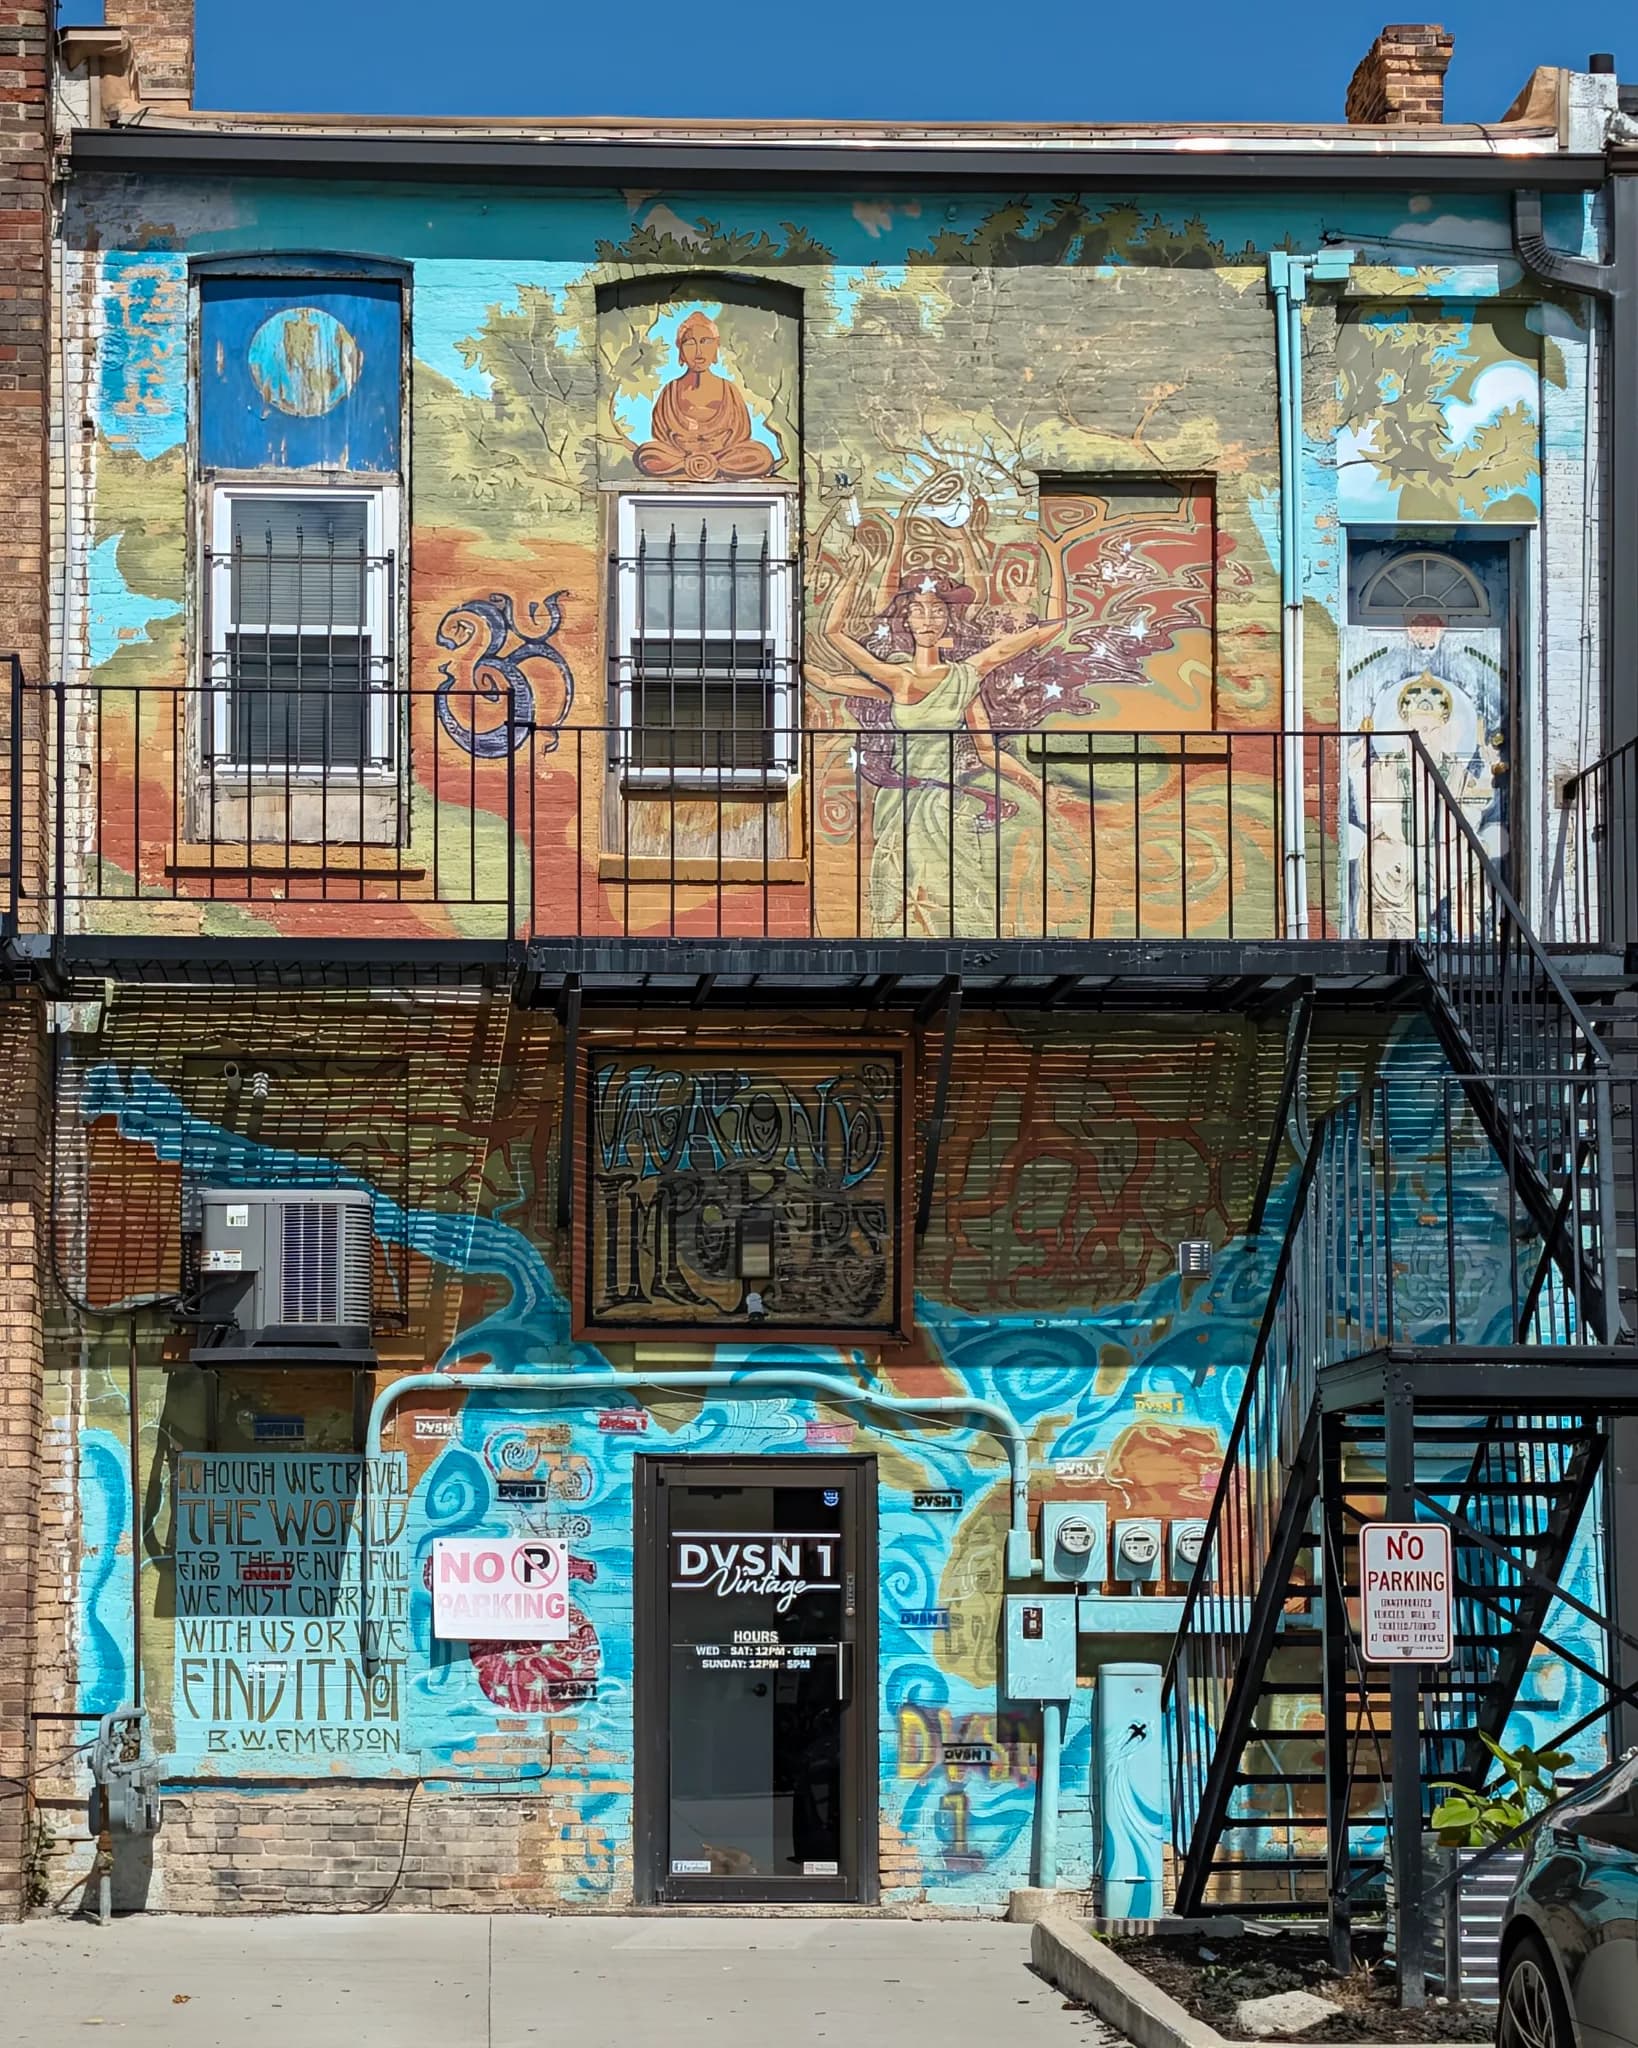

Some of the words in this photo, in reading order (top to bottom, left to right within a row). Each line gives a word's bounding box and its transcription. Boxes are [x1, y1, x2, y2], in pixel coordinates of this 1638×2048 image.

[284, 1462, 324, 1494] WE
[179, 1499, 262, 1545] THE
[269, 1499, 408, 1546] WORLD
[178, 1551, 220, 1563] TO
[680, 1544, 801, 1577] DVSN
[817, 1545, 831, 1577] 1
[1387, 1536, 1424, 1560] NO
[283, 1551, 408, 1580] BEAUTFUL
[440, 1552, 505, 1583] NO
[717, 1565, 807, 1613] Vintage
[1368, 1571, 1444, 1591] PARKING
[180, 1586, 221, 1615] WE
[228, 1585, 292, 1615] MUST
[299, 1586, 376, 1616] CARRY
[382, 1586, 408, 1616] IT
[438, 1592, 565, 1619] PARKING
[180, 1621, 251, 1652] WITH
[261, 1621, 295, 1652] US
[304, 1621, 346, 1652] OR
[696, 1646, 720, 1656] WED
[730, 1646, 753, 1656] SAT:
[755, 1646, 785, 1656] 12PM
[793, 1646, 817, 1656] 6PM
[734, 1630, 780, 1643] HOURS
[702, 1659, 747, 1669] SUNDAY:
[749, 1659, 779, 1669] 12PM
[786, 1659, 811, 1669] 5PM
[181, 1658, 287, 1722] FIND
[295, 1658, 336, 1721] IT
[345, 1658, 407, 1722] NOT
